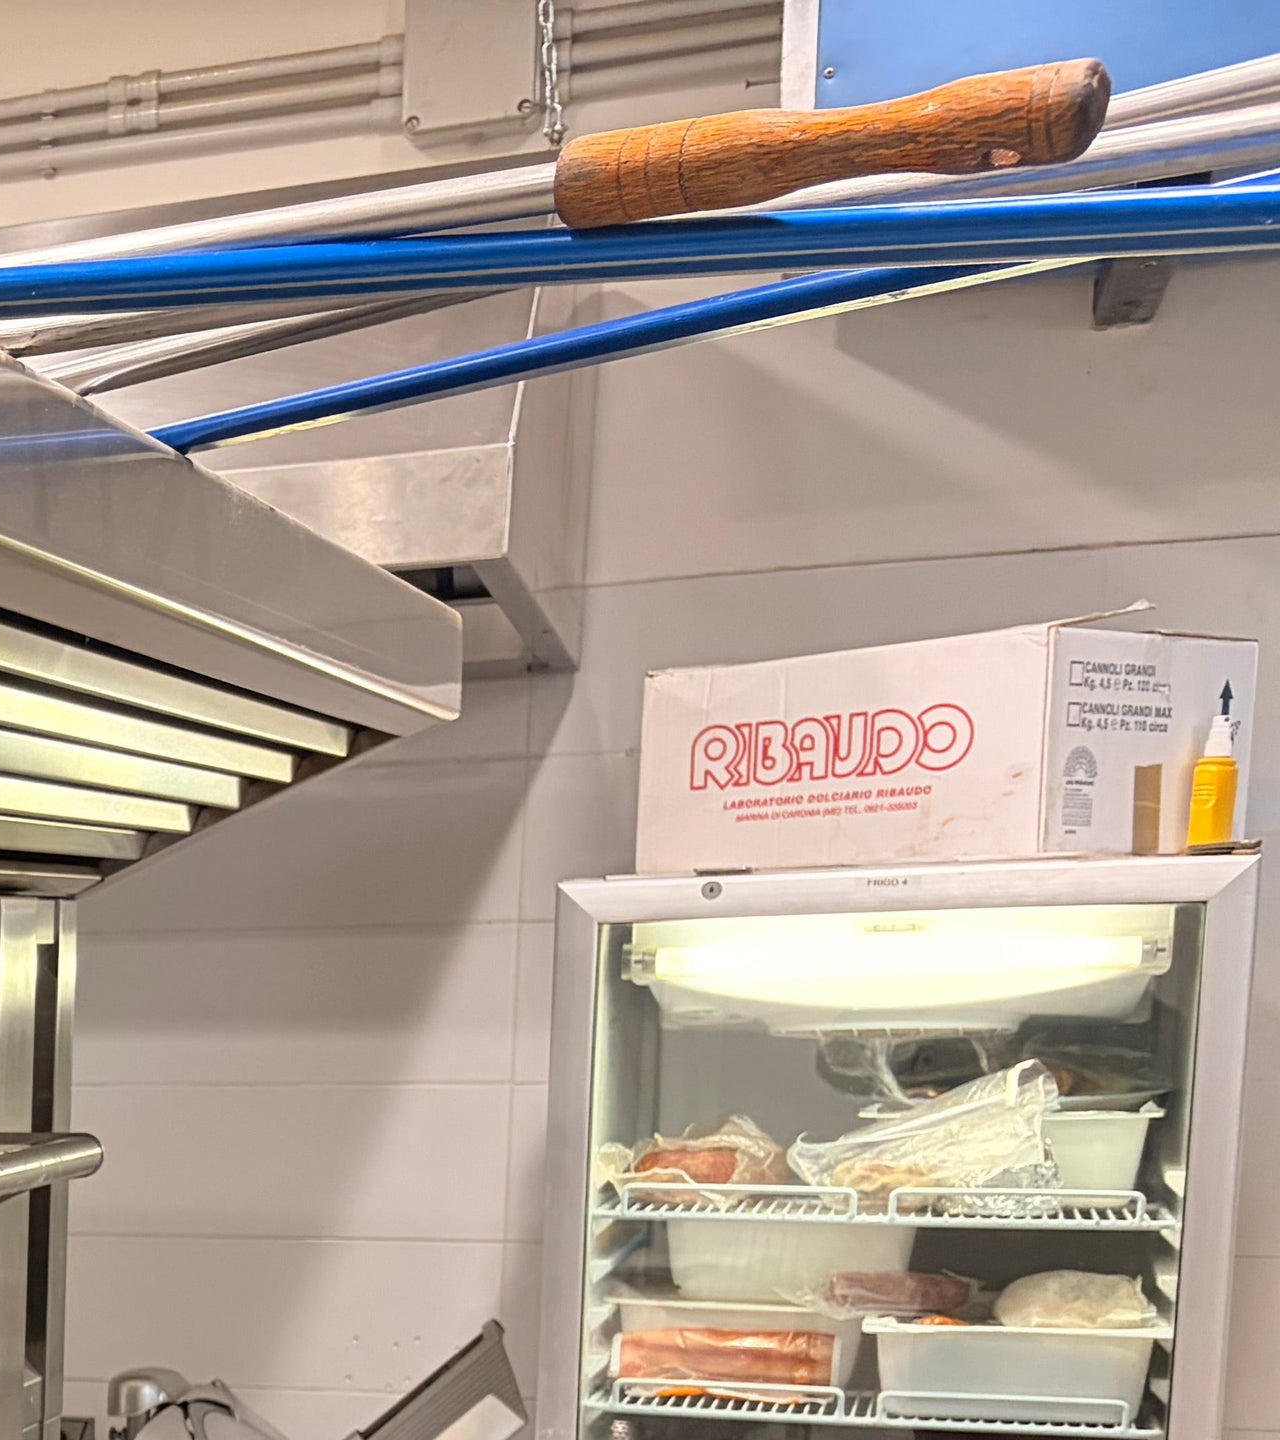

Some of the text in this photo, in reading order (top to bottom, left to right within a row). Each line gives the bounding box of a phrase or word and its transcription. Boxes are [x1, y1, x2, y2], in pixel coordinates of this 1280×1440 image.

[1085, 661, 1156, 677] CANNOLI GRANDI
[1081, 702, 1172, 719] CANNOLI GRANDI MAX
[1149, 721, 1168, 733] circa
[690, 703, 975, 790] RIBAUDO
[723, 785, 932, 811] LABORATORIO DOLCIARIO RIBAUDO
